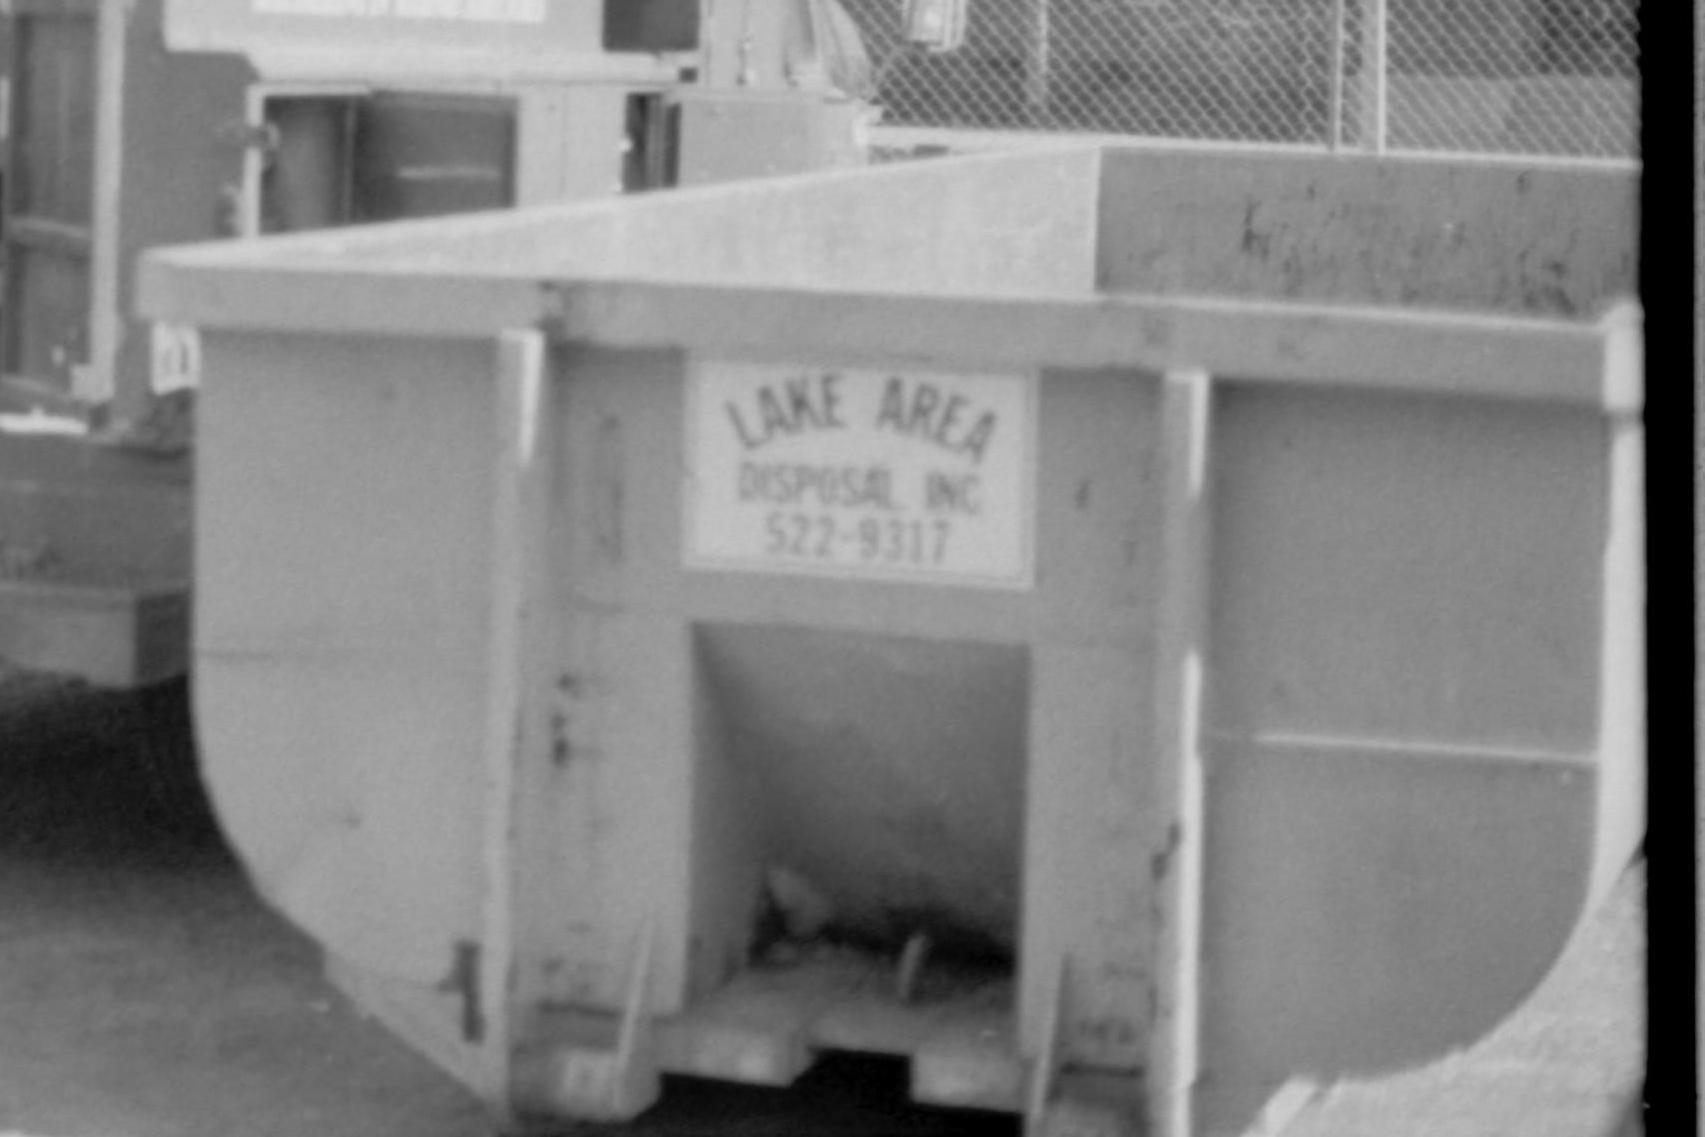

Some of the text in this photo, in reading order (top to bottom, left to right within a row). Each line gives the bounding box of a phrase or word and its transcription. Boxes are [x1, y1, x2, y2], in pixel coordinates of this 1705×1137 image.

[724, 373, 997, 464] LAKE AREA
[765, 512, 952, 563] 522-9317
